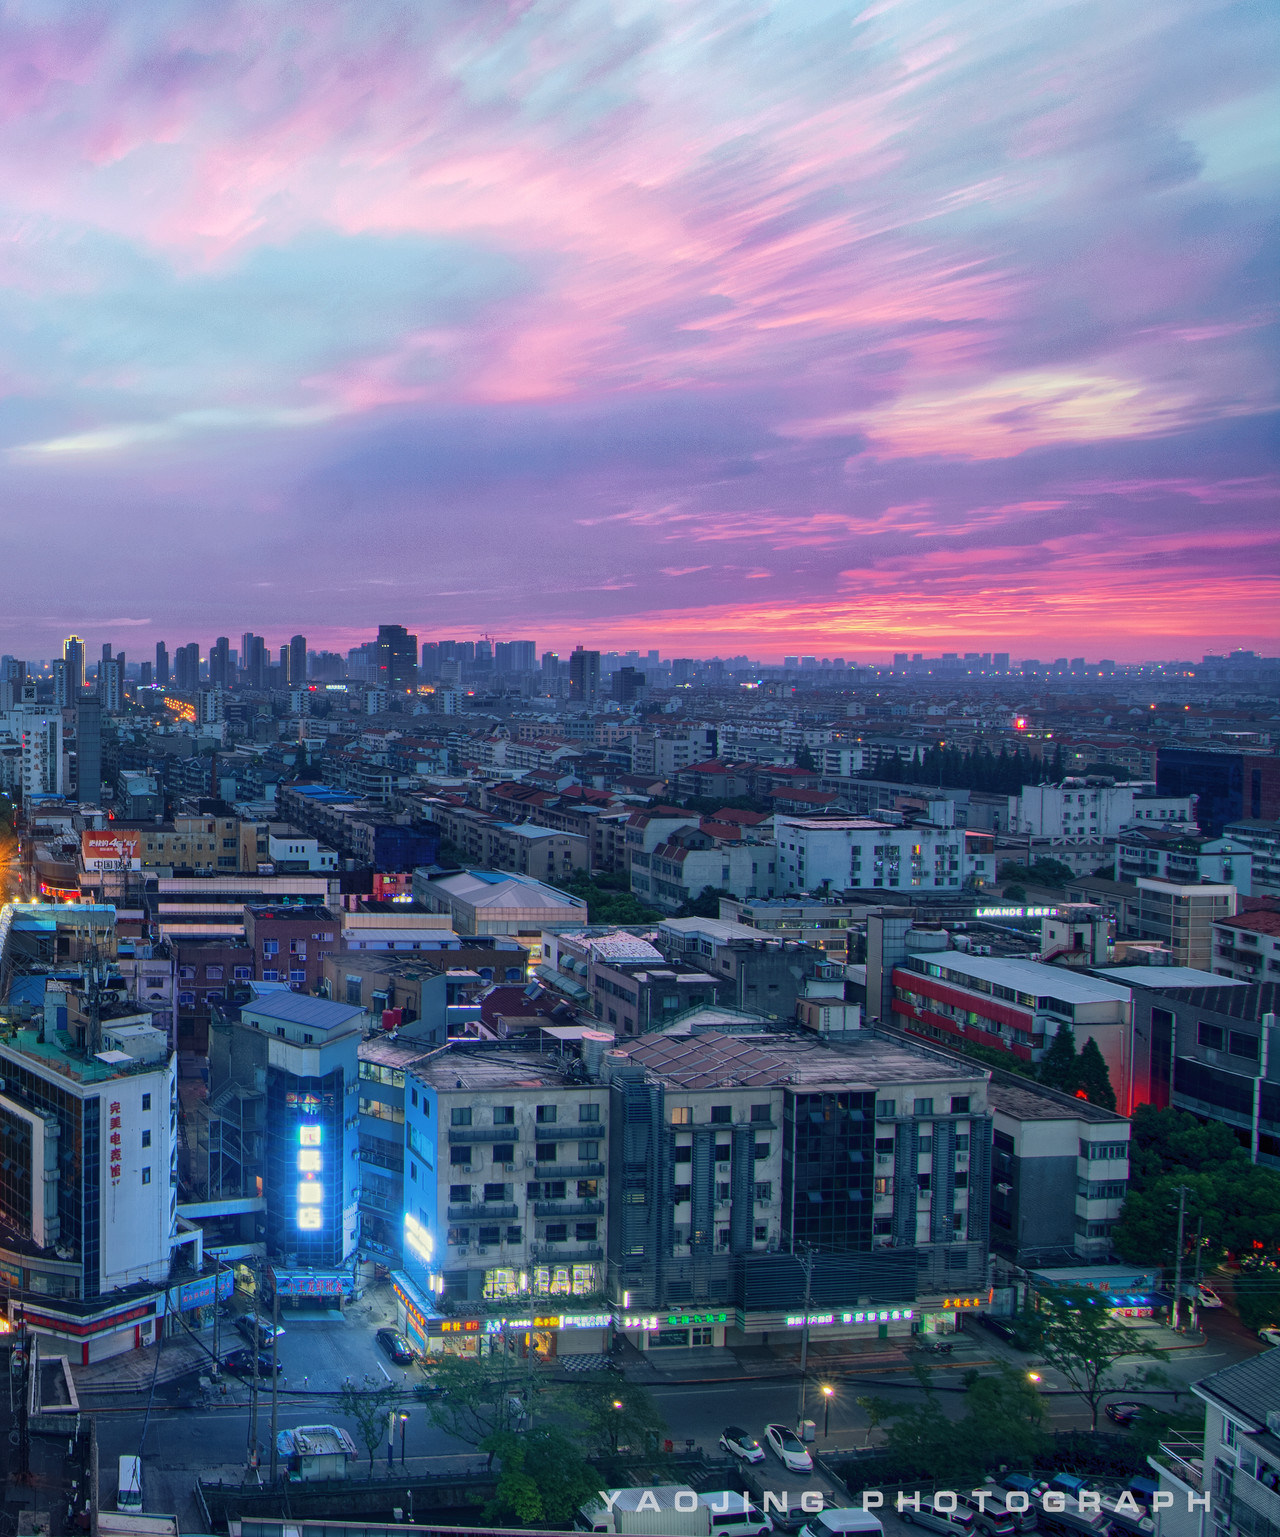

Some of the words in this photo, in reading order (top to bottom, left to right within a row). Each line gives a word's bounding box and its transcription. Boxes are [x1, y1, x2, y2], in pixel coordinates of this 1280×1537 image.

[976, 908, 1023, 917] LAVANDE
[109, 1100, 122, 1179] 完美电竞馆
